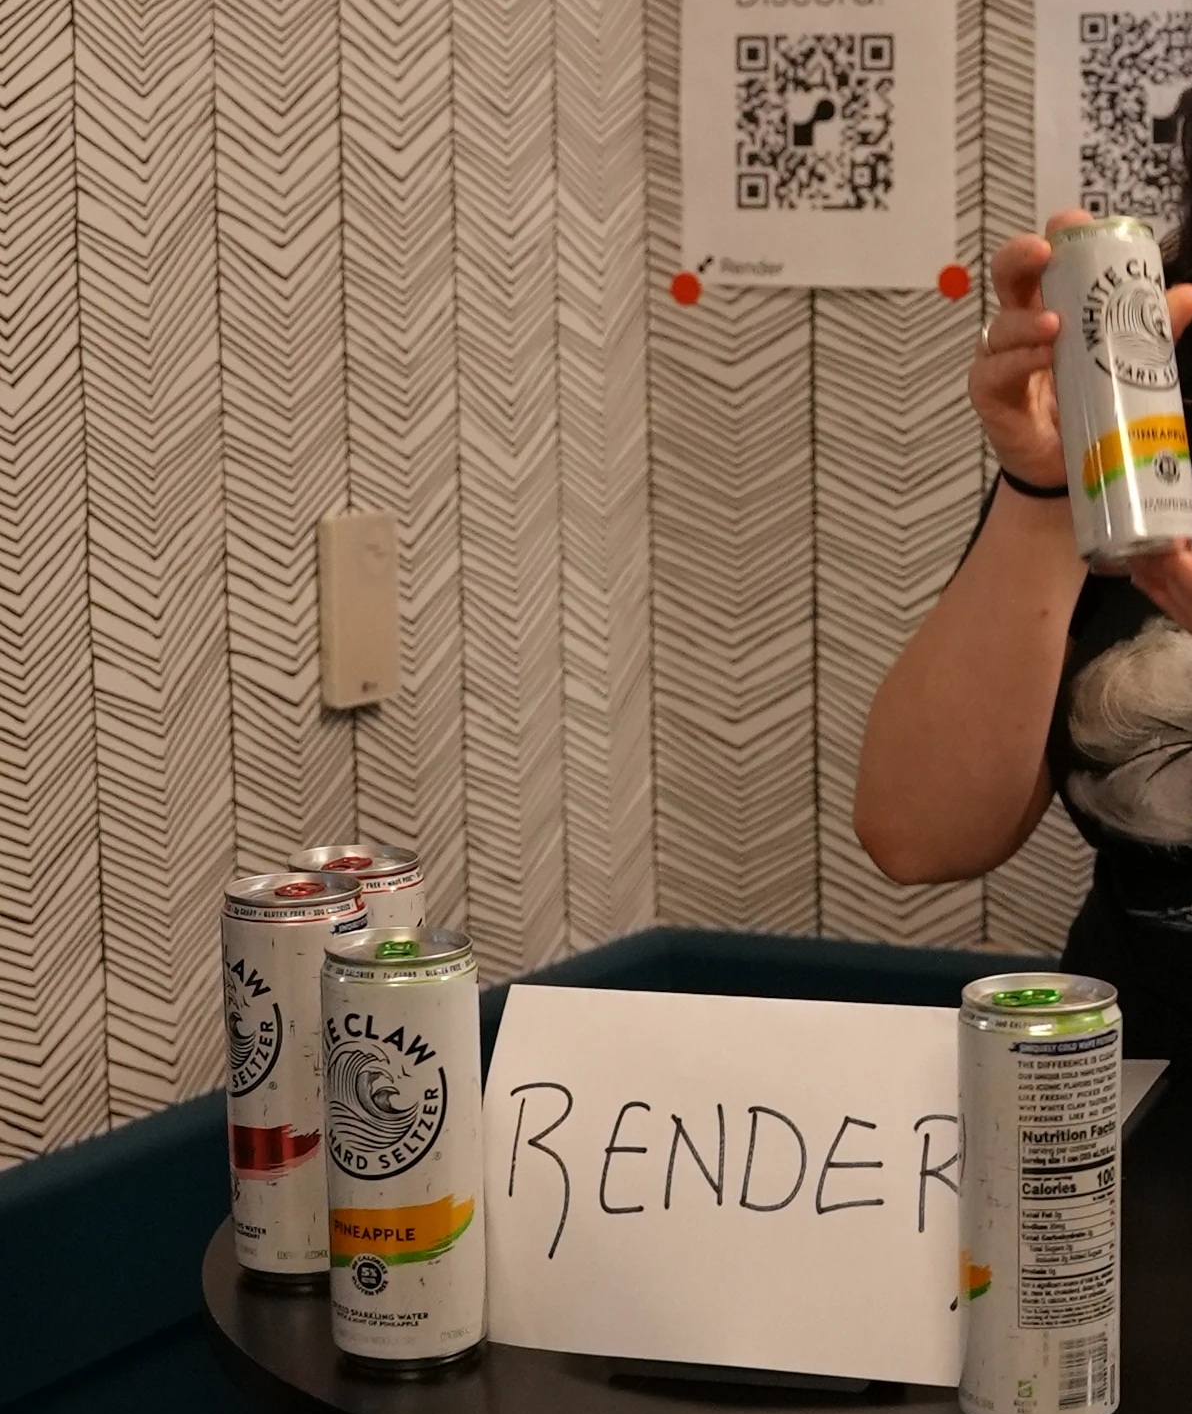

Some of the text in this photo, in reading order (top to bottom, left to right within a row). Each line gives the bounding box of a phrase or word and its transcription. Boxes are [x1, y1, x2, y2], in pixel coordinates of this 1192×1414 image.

[720, 257, 784, 276] Render
[1082, 258, 1165, 351] WHITE CLA
[225, 945, 271, 998] LAW
[232, 1021, 274, 1088] SELTZER
[344, 1013, 436, 1066] CLAW
[329, 1087, 439, 1170] HARD SELTZER
[1022, 1120, 1116, 1143] Nutrition Facts
[509, 1081, 959, 1259] RENDER
[1022, 1181, 1076, 1195] Calories
[333, 1219, 416, 1242] PINEAPPLE
[351, 1308, 429, 1320] SPARKLING WATER
